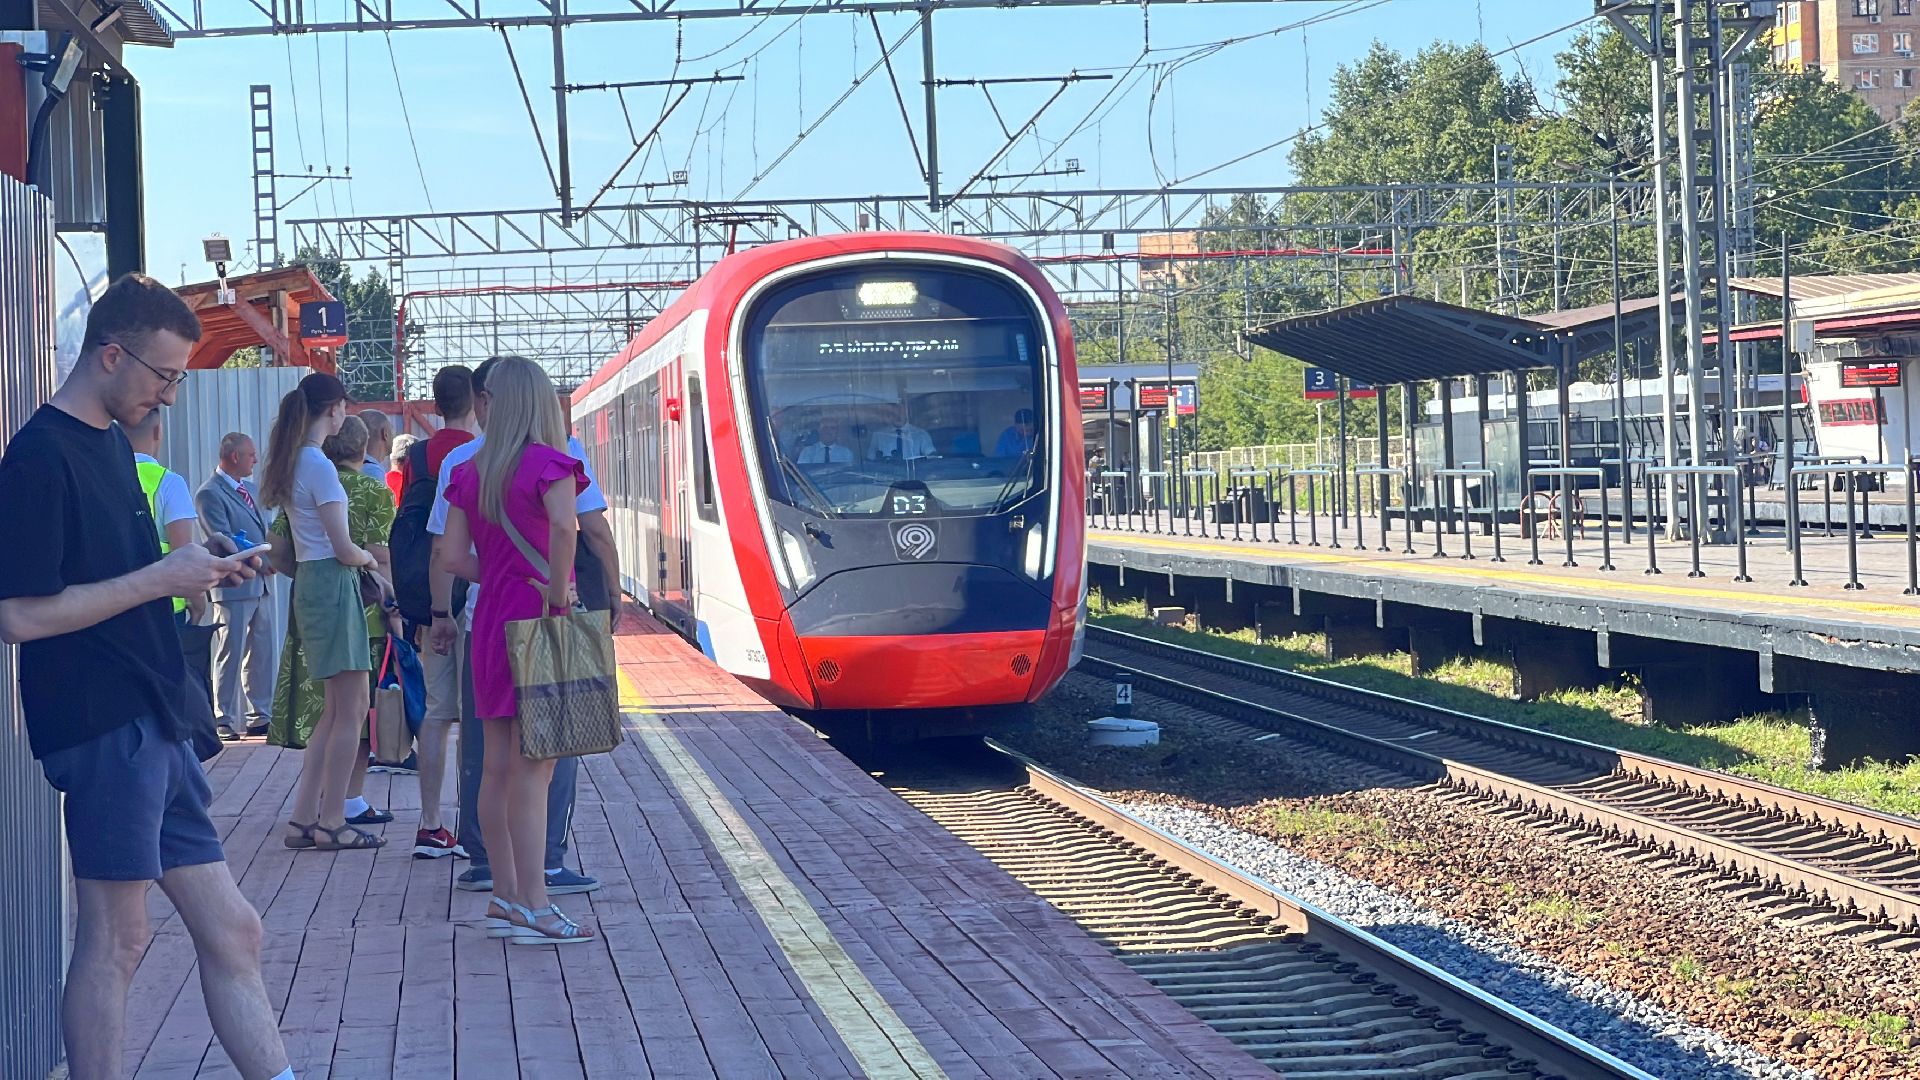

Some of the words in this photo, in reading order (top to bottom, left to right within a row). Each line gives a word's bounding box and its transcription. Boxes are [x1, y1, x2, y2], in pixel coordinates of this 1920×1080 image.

[318, 306, 327, 326] 1
[1315, 371, 1325, 386] 3
[893, 495, 926, 515] D3
[1117, 684, 1130, 702] 4
